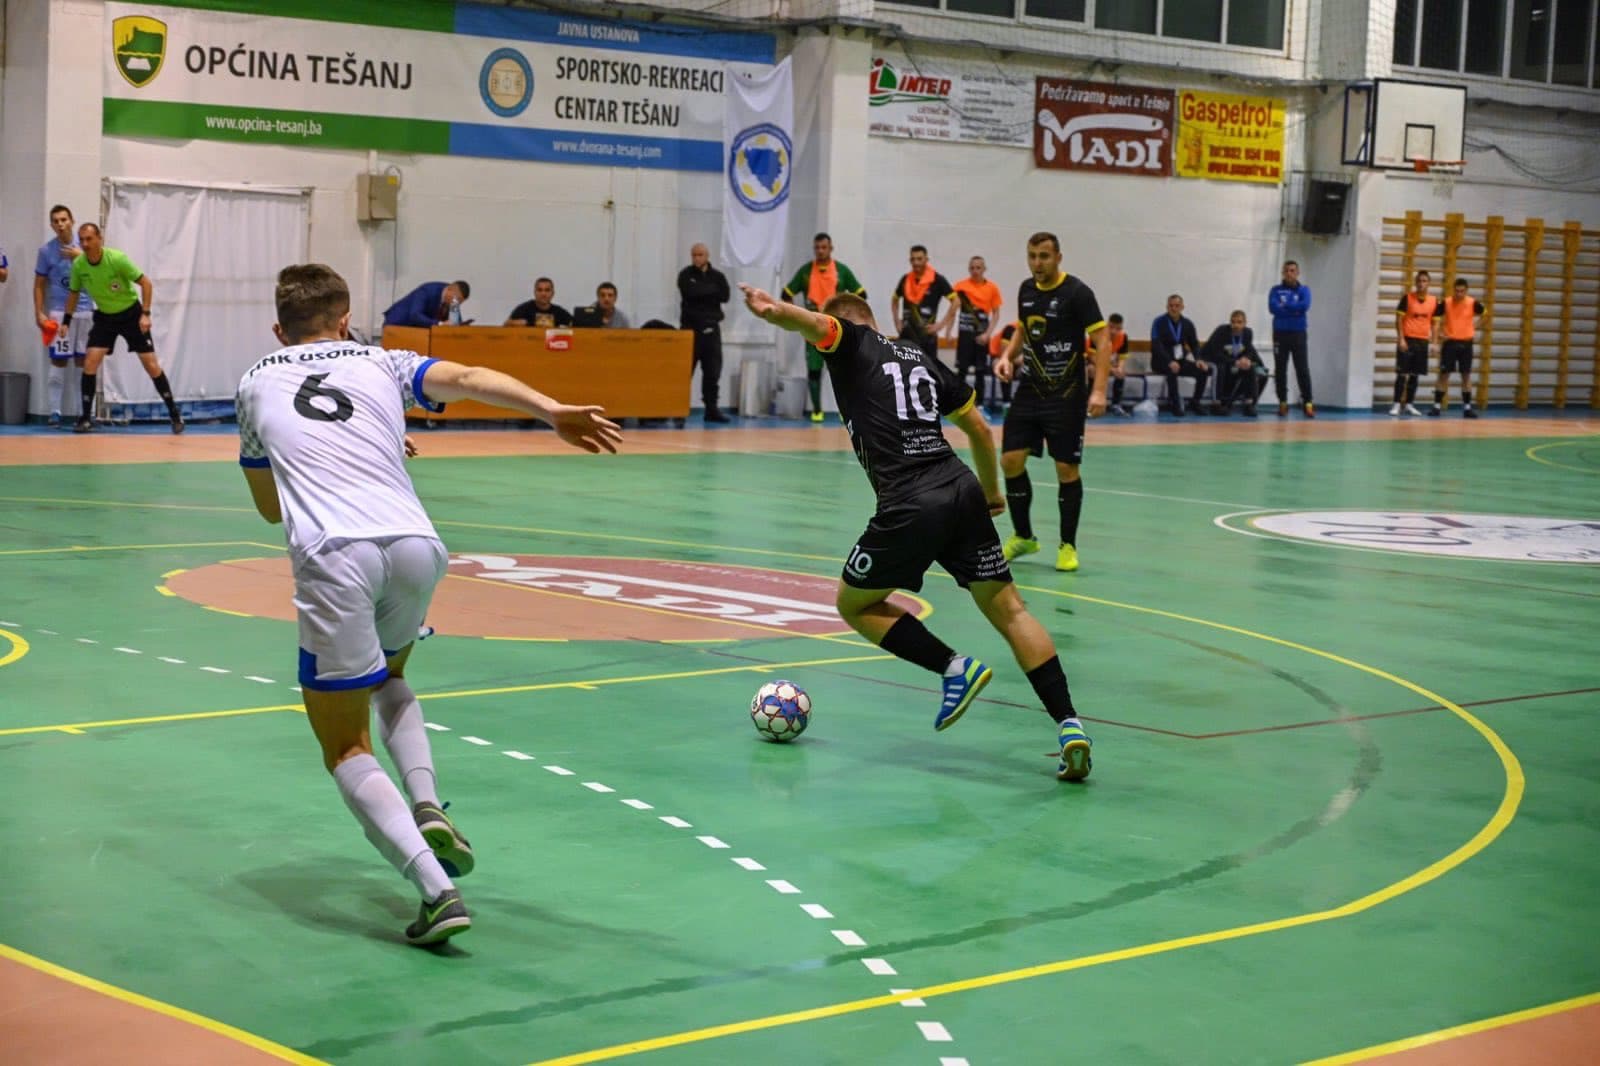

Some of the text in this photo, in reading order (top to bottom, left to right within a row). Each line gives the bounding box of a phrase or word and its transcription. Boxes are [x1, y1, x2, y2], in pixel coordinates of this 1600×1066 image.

[558, 22, 640, 43] JAVNA USTANOVA
[184, 44, 413, 90] OPĆINA TEŠANJ
[556, 56, 752, 93] SPORTSKO-REKREACI
[899, 75, 952, 96] INTER
[205, 114, 323, 137] www.opcina-tesanj.ba
[554, 95, 680, 128] CENTAR TEŠANJ
[1182, 93, 1273, 130] Gaspetrol
[1038, 108, 1164, 169] MADI
[56, 341, 69, 352] 15
[293, 372, 354, 423] 6
[882, 361, 939, 422] 10
[849, 544, 873, 574] 10
